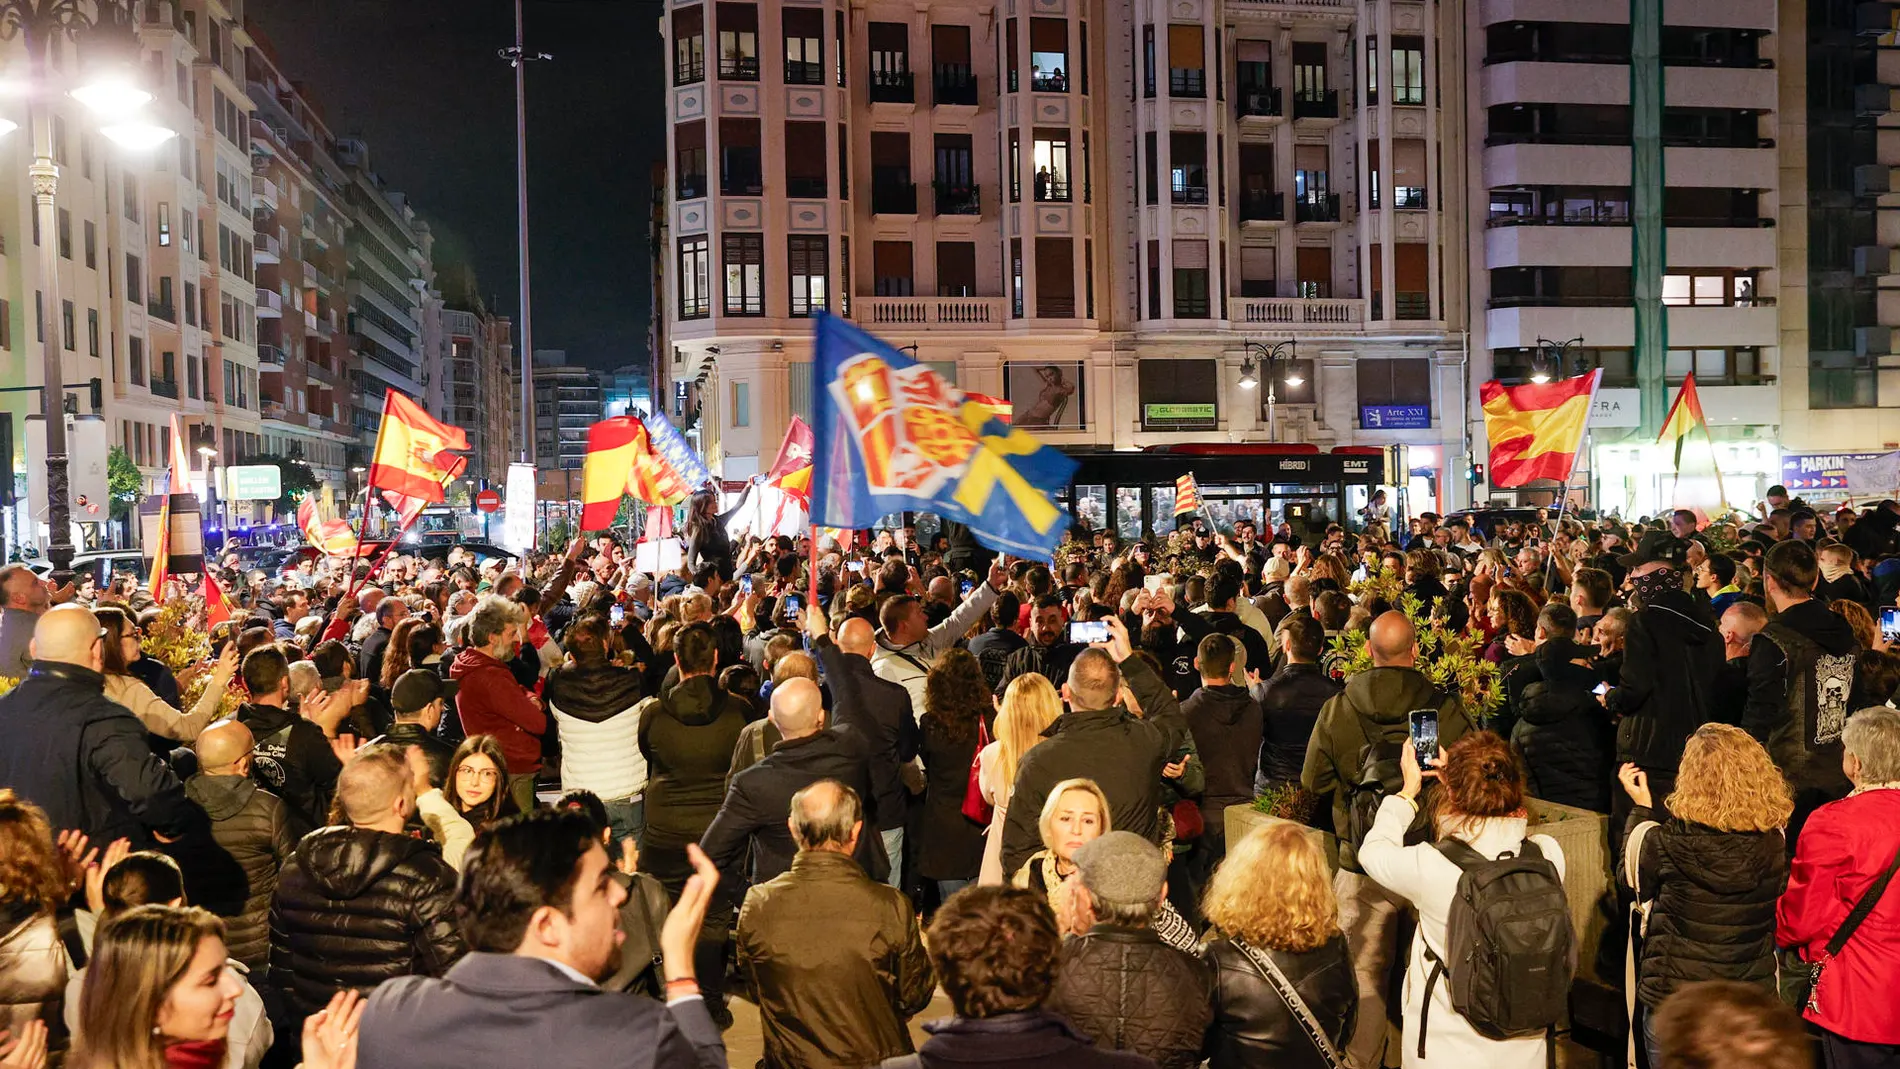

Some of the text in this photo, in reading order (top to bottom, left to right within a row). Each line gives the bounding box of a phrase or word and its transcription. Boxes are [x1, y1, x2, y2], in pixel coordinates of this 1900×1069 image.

[1386, 408, 1423, 416] Arte XXI
[1279, 458, 1307, 470] HÍBRID
[271, 750, 286, 759] City
